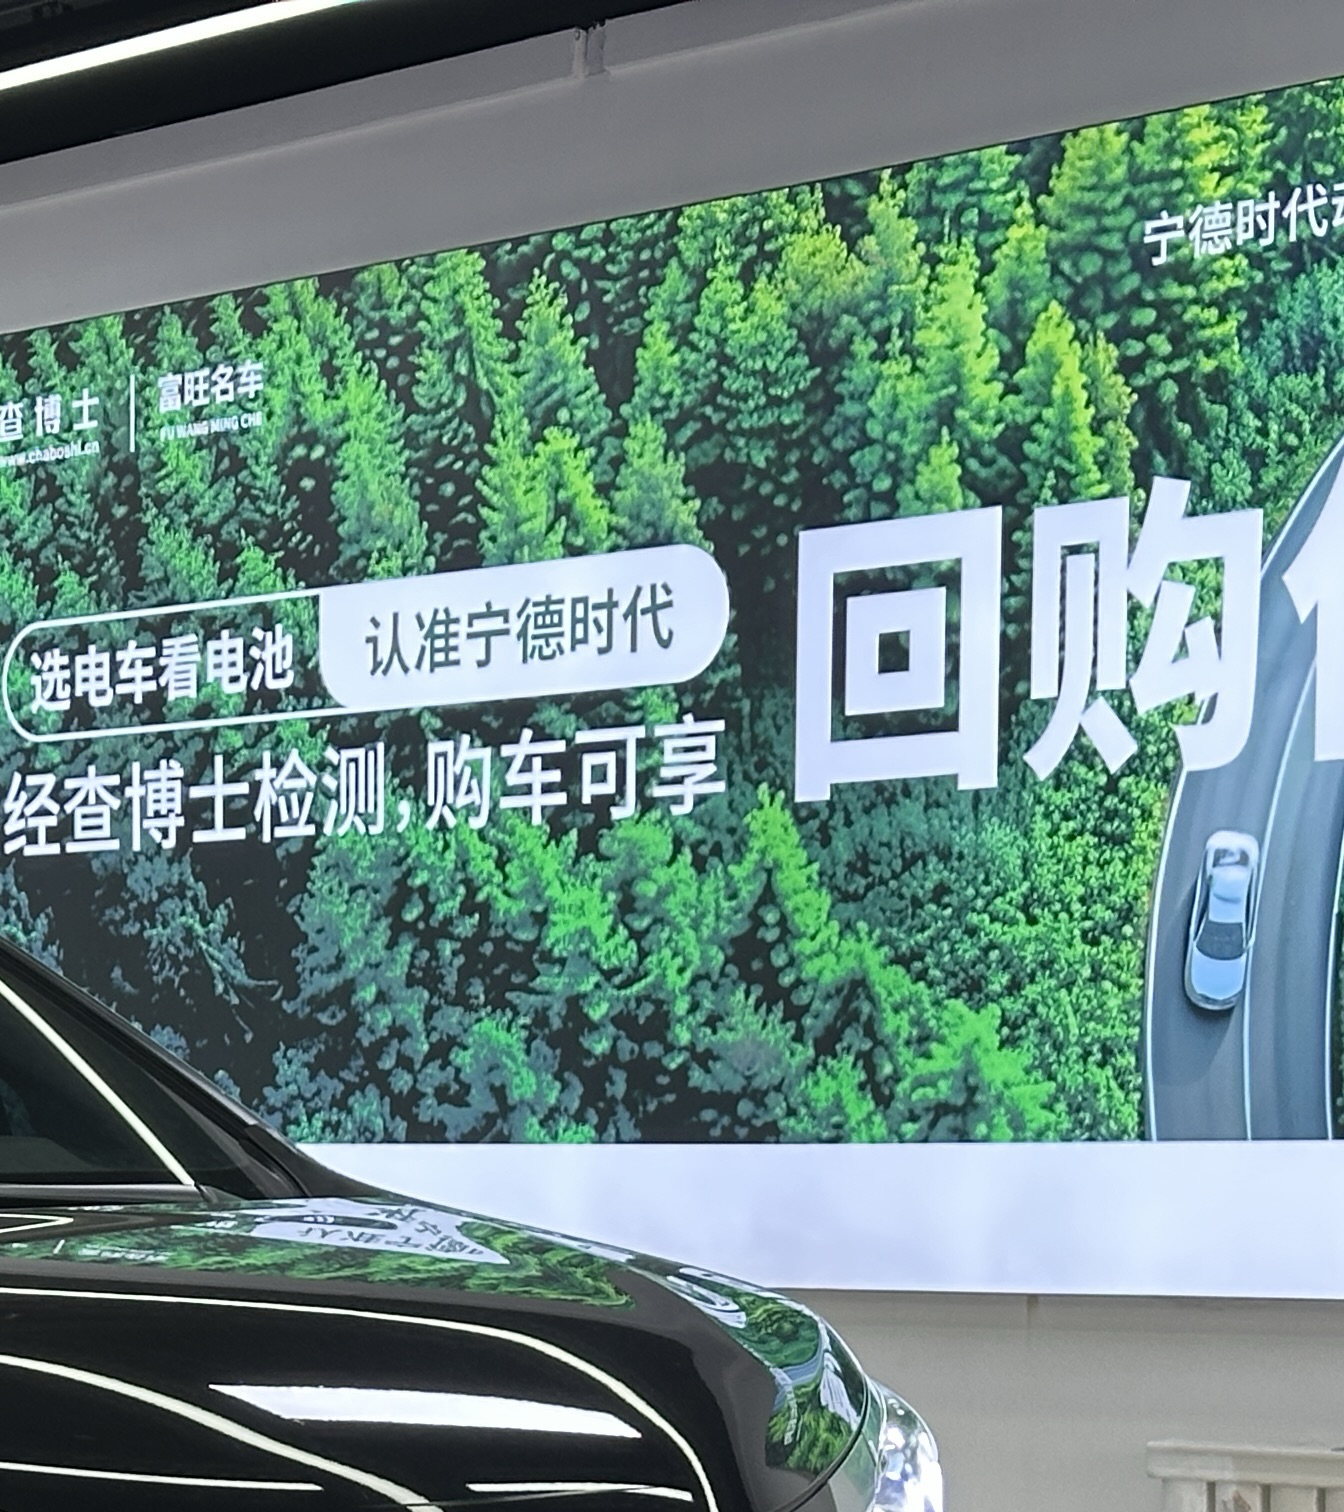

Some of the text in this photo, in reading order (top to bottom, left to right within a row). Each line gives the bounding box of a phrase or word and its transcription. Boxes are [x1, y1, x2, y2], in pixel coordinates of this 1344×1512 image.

[157, 359, 264, 414] 富旺名车
[30, 582, 675, 715] 选电车看电池 认准宁德时代
